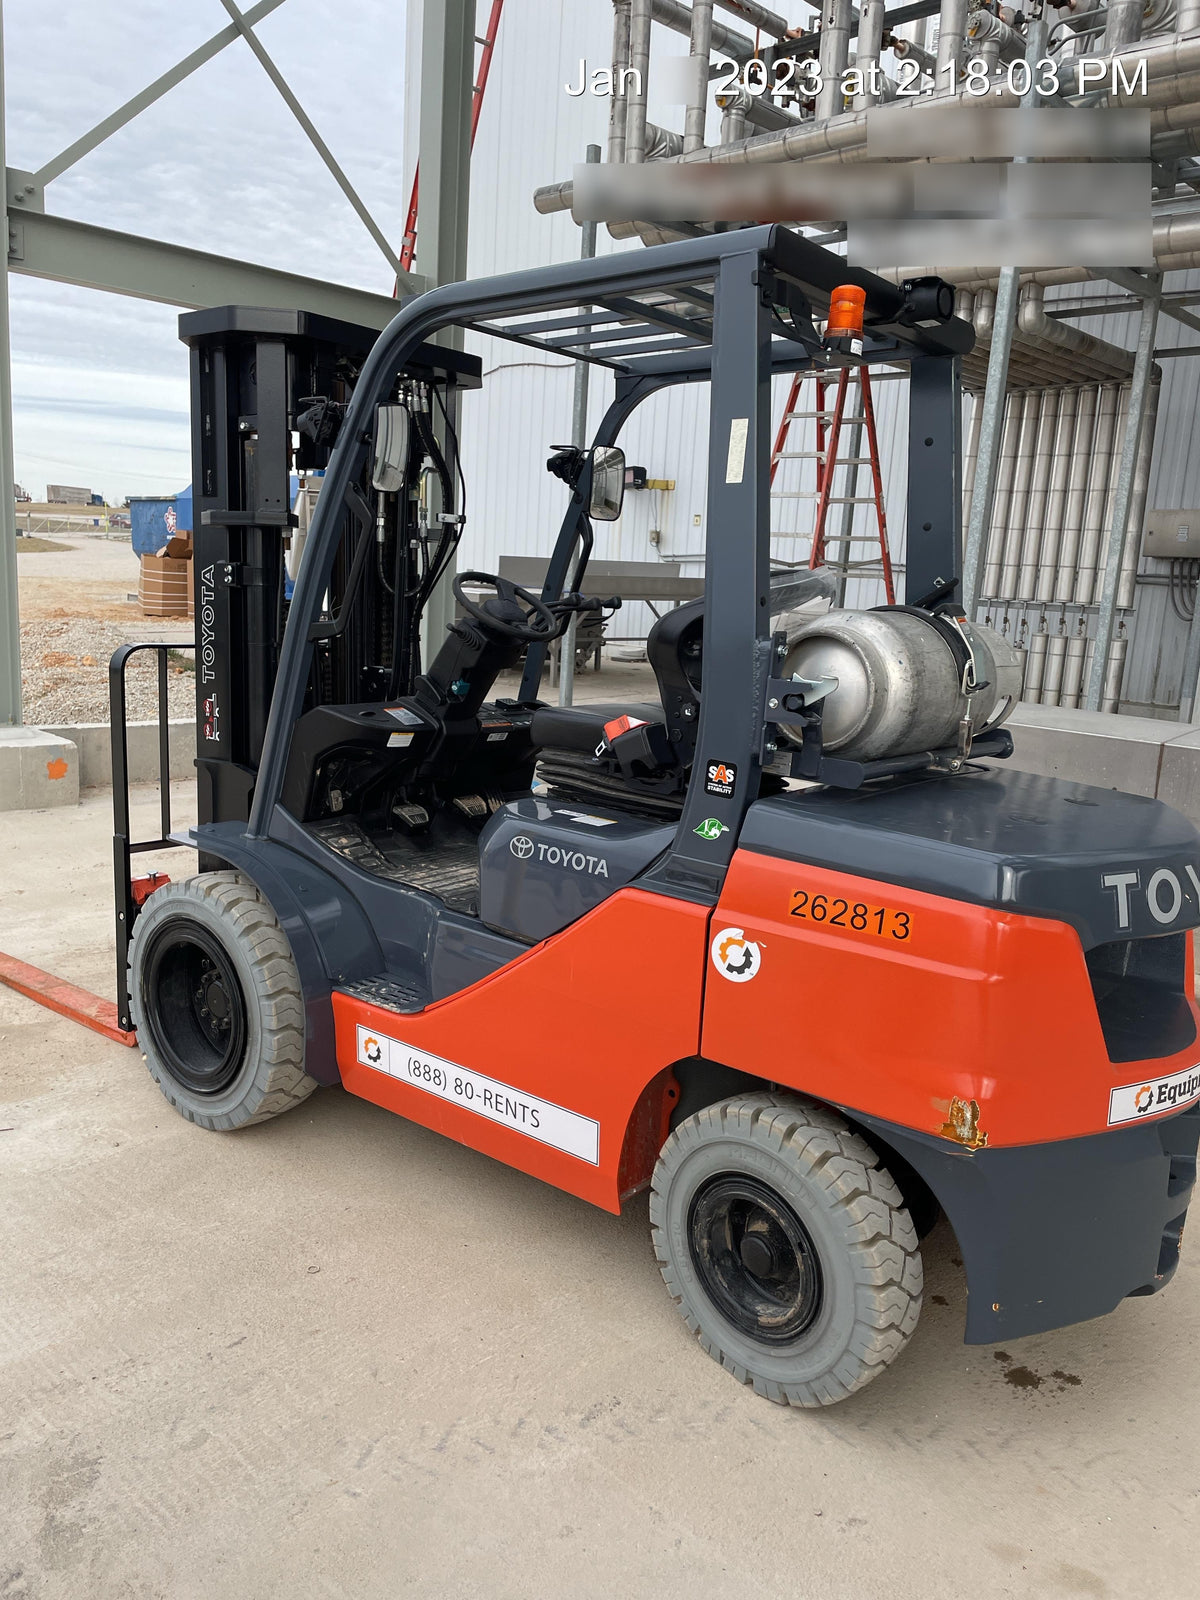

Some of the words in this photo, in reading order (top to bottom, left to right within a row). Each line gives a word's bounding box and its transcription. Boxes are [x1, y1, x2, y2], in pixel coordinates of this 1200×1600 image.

[201, 564, 216, 684] TOYOTA
[707, 764, 735, 785] SAS
[707, 785, 732, 795] STABILITY
[537, 843, 609, 878] TOYOTA
[790, 890, 910, 939] 262813
[407, 1056, 448, 1091] (888)
[453, 1077, 541, 1129] 80-RENTS
[1155, 1073, 1200, 1105] Equip
